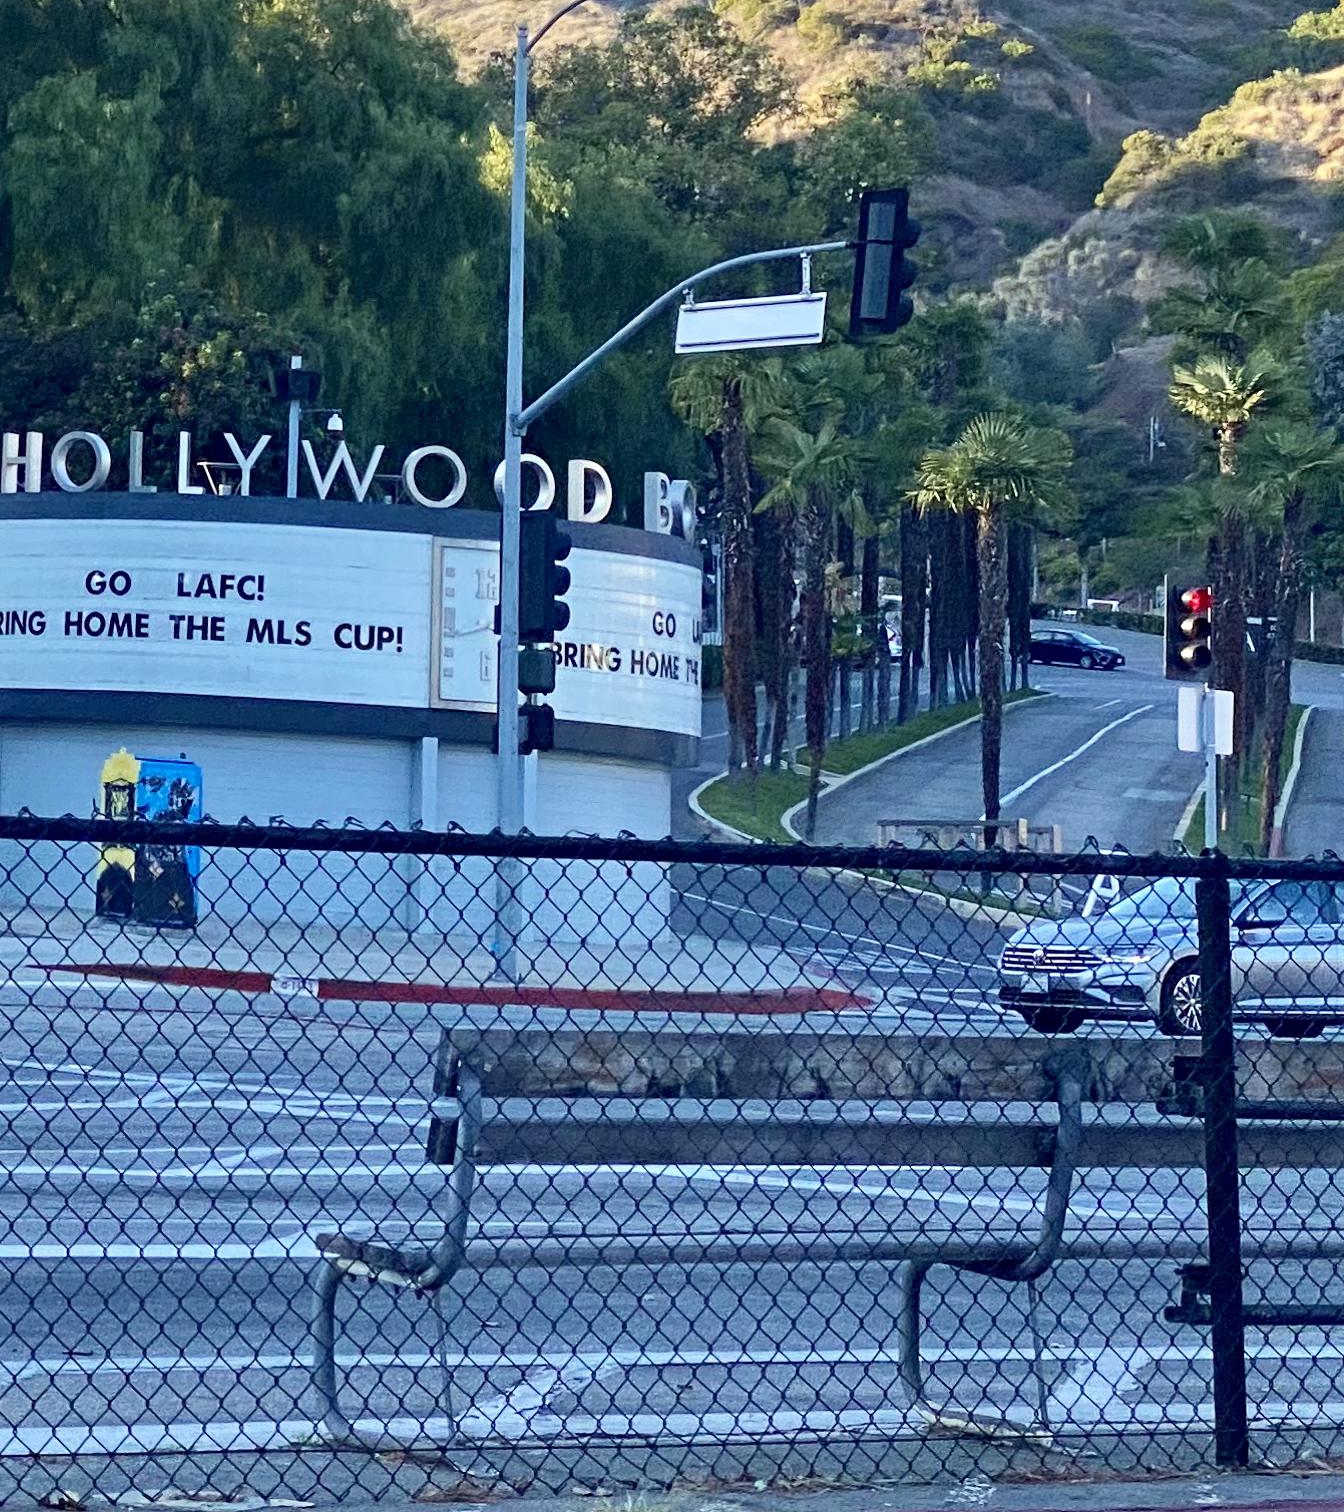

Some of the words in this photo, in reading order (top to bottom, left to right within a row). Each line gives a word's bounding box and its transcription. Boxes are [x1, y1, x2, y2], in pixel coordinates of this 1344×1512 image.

[1, 431, 612, 524] HOLLYWOOD
[85, 570, 132, 596] GO
[177, 573, 265, 601] LAFC!
[64, 611, 149, 638] HOME
[169, 614, 225, 642] THE
[246, 618, 312, 647] MLS
[334, 623, 403, 652] CUP!
[652, 611, 676, 638] GO
[553, 641, 621, 672] BRING
[631, 650, 679, 680] HOME
